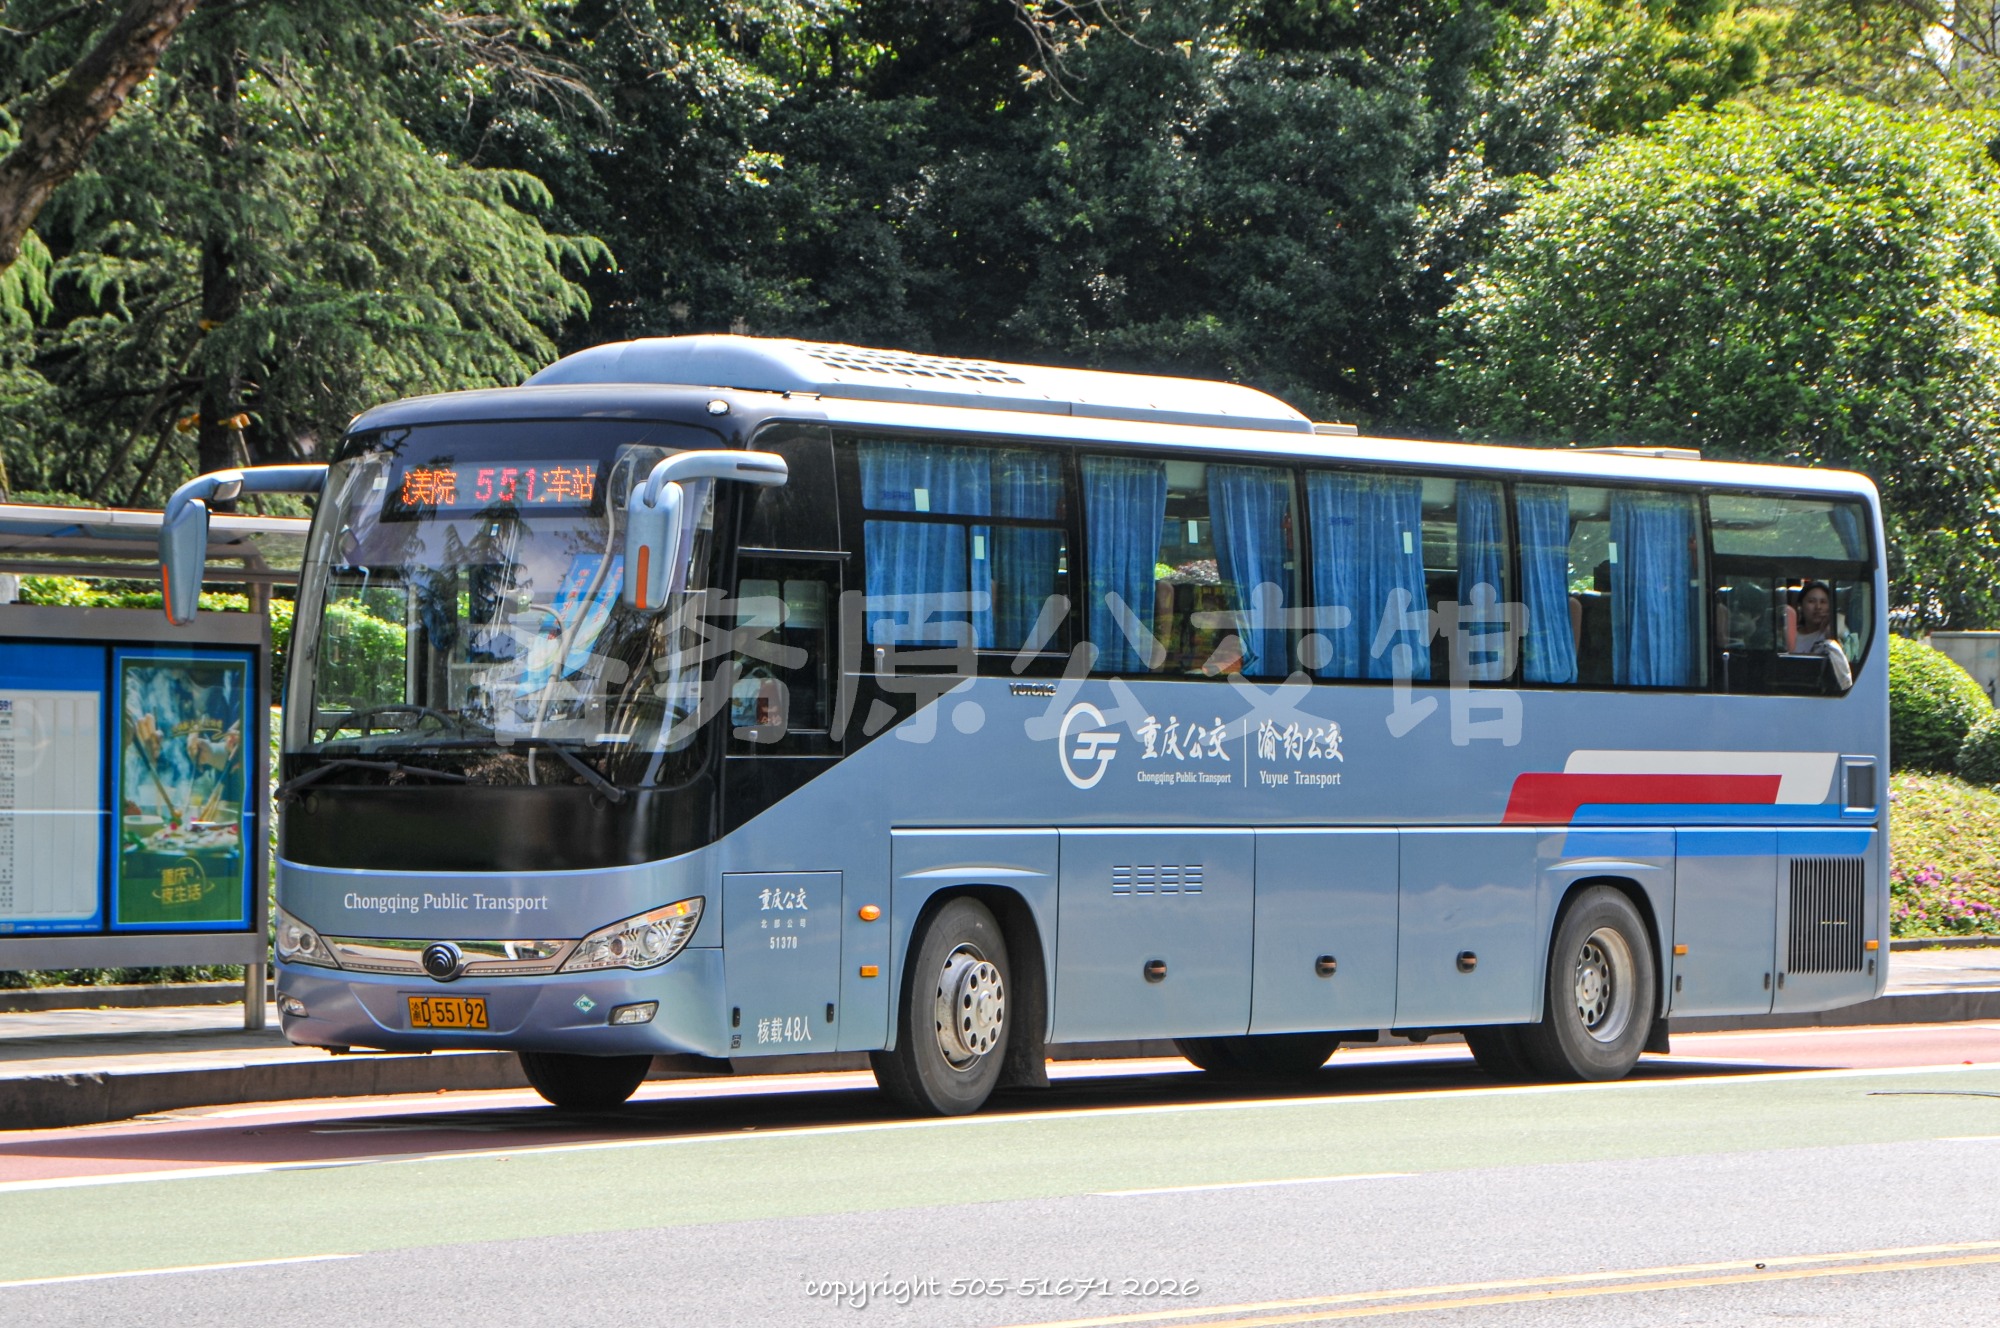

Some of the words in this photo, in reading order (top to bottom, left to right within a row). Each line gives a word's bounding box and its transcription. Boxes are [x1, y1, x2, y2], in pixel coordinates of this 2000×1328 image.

[475, 467, 536, 502] 551
[1009, 682, 1057, 697] YUTONG
[1137, 715, 1231, 762] 重庆公交
[1137, 771, 1175, 785] Chongqing
[1176, 772, 1197, 783] Public
[1198, 772, 1232, 786] Transport
[1260, 770, 1289, 789] Yuyue
[1294, 770, 1342, 789] Transport
[344, 893, 420, 914] Chongqing
[423, 893, 469, 910] Public
[473, 893, 549, 914] Transport
[758, 888, 809, 911] 重庆公交
[769, 936, 798, 950] 51370
[757, 1016, 812, 1044] 核载48人
